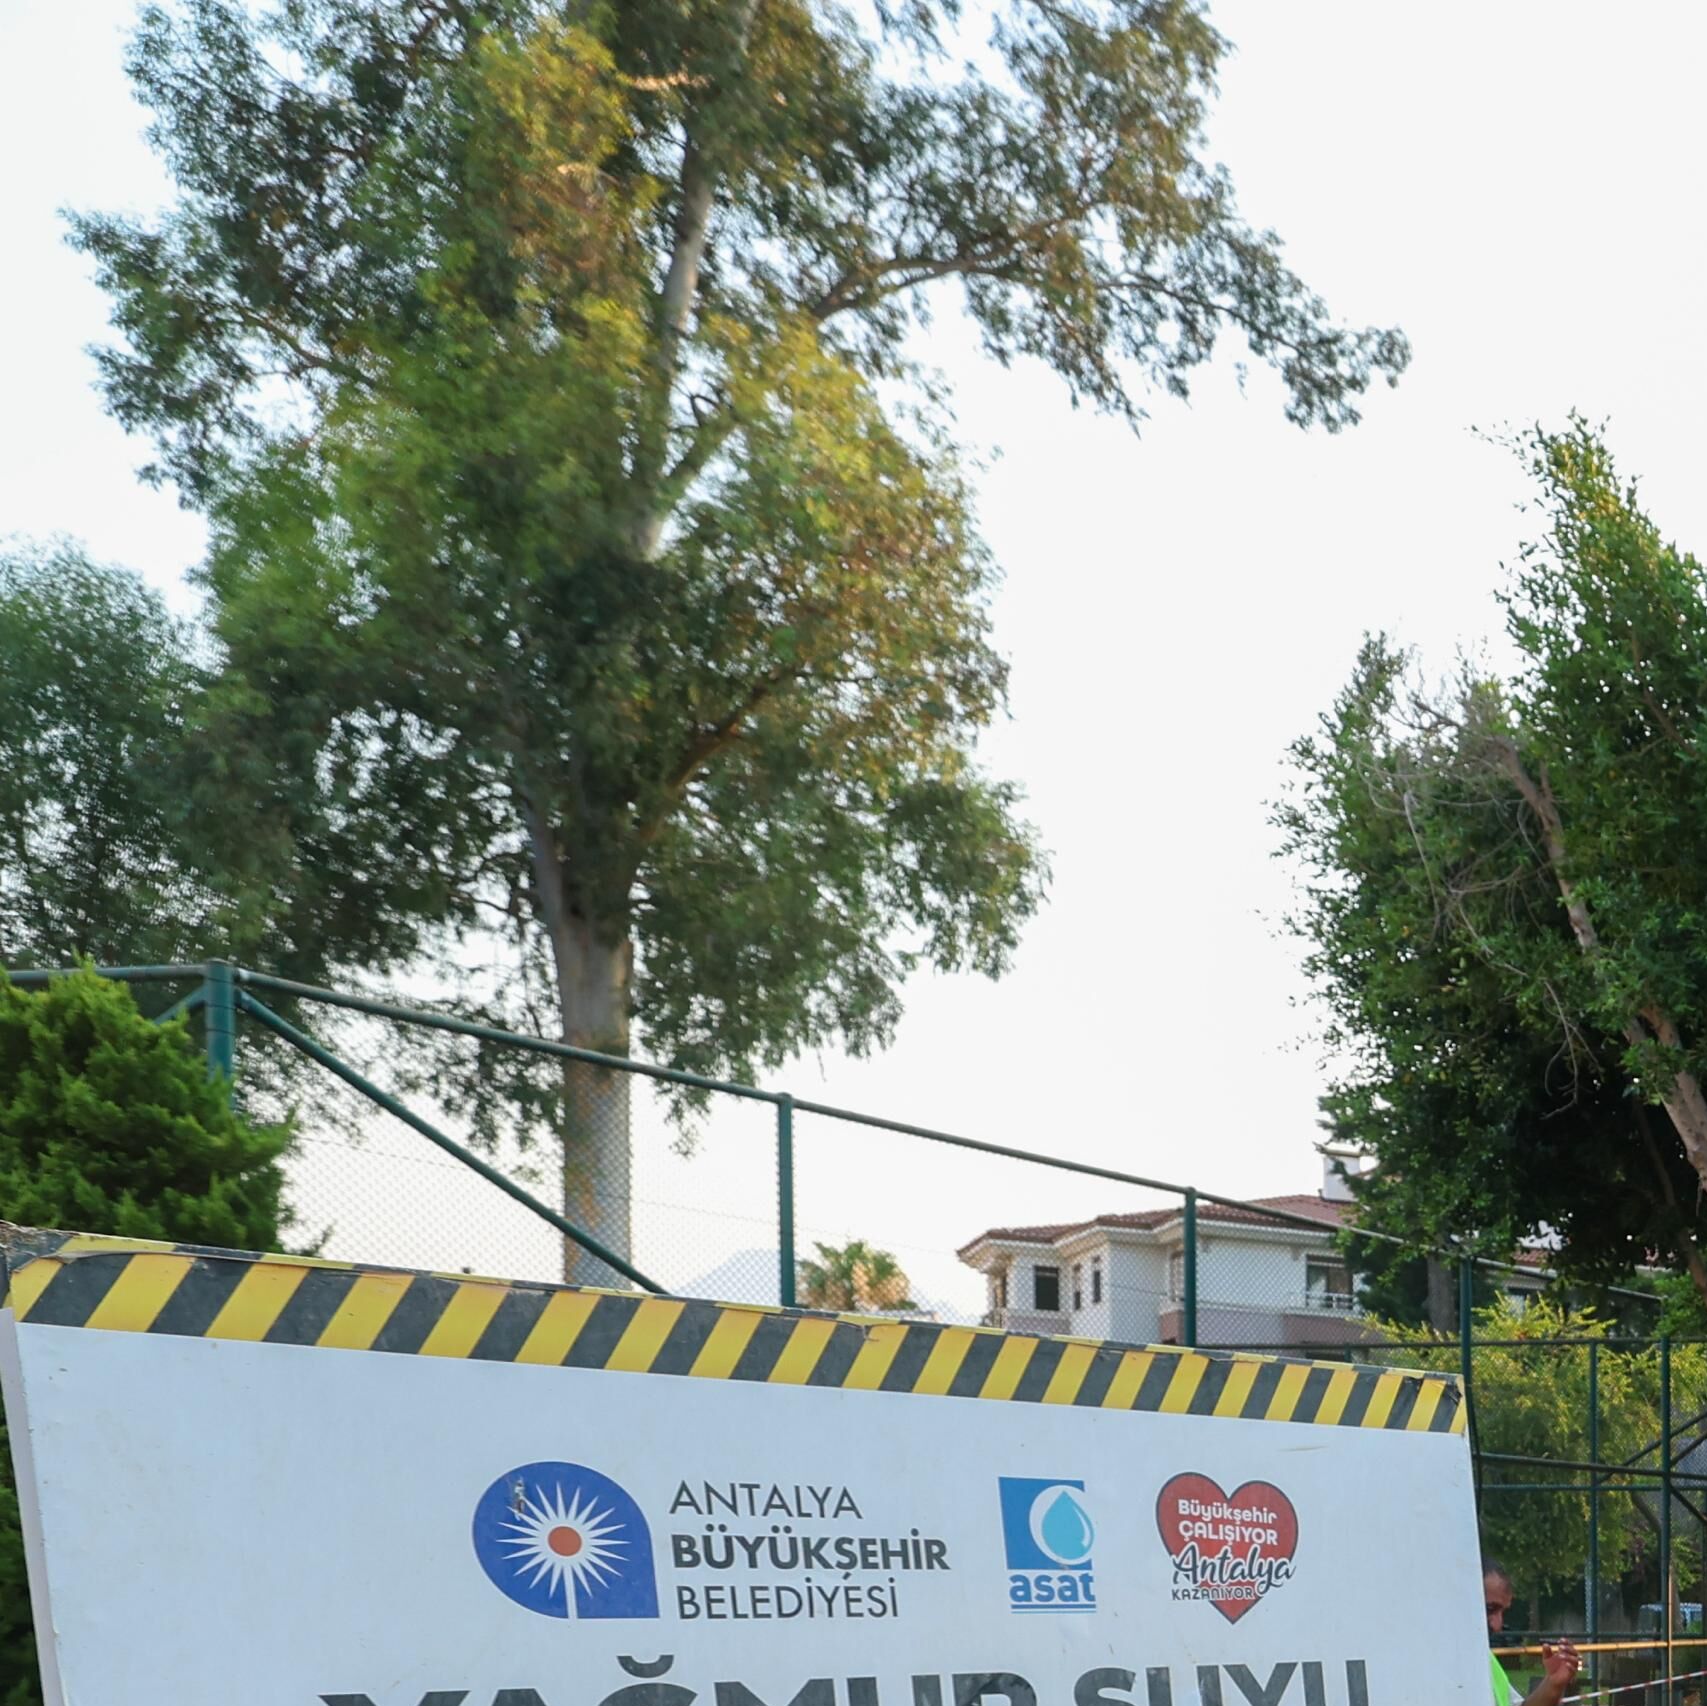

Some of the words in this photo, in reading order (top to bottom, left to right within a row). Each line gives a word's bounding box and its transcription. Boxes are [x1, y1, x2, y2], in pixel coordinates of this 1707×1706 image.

[669, 1480, 863, 1520] ANTALYA
[1177, 1499, 1278, 1525] Büyükşehir
[671, 1523, 951, 1581] BÜYÜKŞEHİR
[1172, 1543, 1297, 1595] Antalya
[676, 1575, 898, 1620] BELEDİYESİ
[1009, 1573, 1097, 1603] asat
